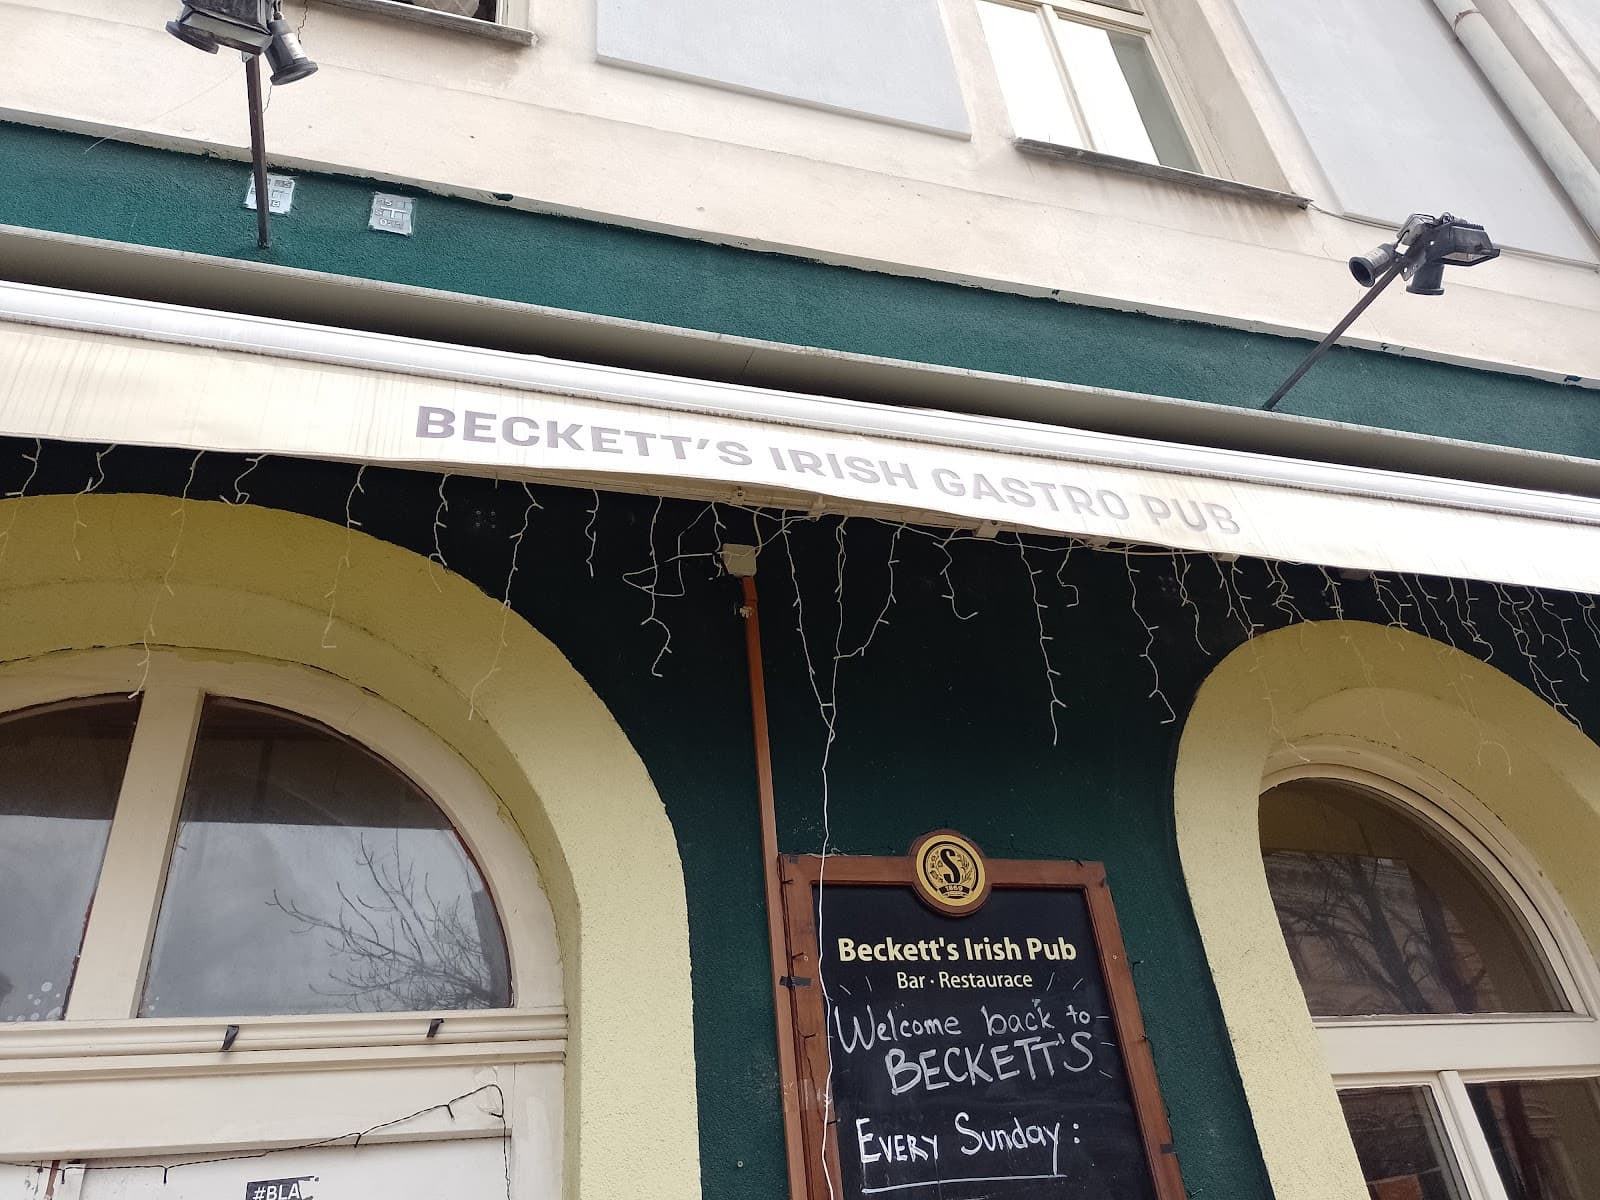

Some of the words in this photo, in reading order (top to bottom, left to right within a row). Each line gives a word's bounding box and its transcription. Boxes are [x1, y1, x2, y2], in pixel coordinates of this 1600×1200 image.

[416, 405, 753, 467] BECKETT'S
[769, 446, 918, 490] IRISH
[931, 467, 1130, 521] GASTRO
[1139, 493, 1241, 535] PUB
[940, 848, 961, 884] S
[838, 937, 959, 962] Beckett's
[965, 937, 1022, 961] Irish
[1028, 937, 1077, 961] Pub
[897, 972, 926, 989] Bar
[940, 971, 1033, 989] Restaurace
[834, 1003, 962, 1055] Welcome
[981, 1003, 1055, 1036] back
[1066, 1004, 1091, 1026] to
[885, 1031, 1094, 1096] BECKETT'S
[856, 1118, 940, 1164] EVERY
